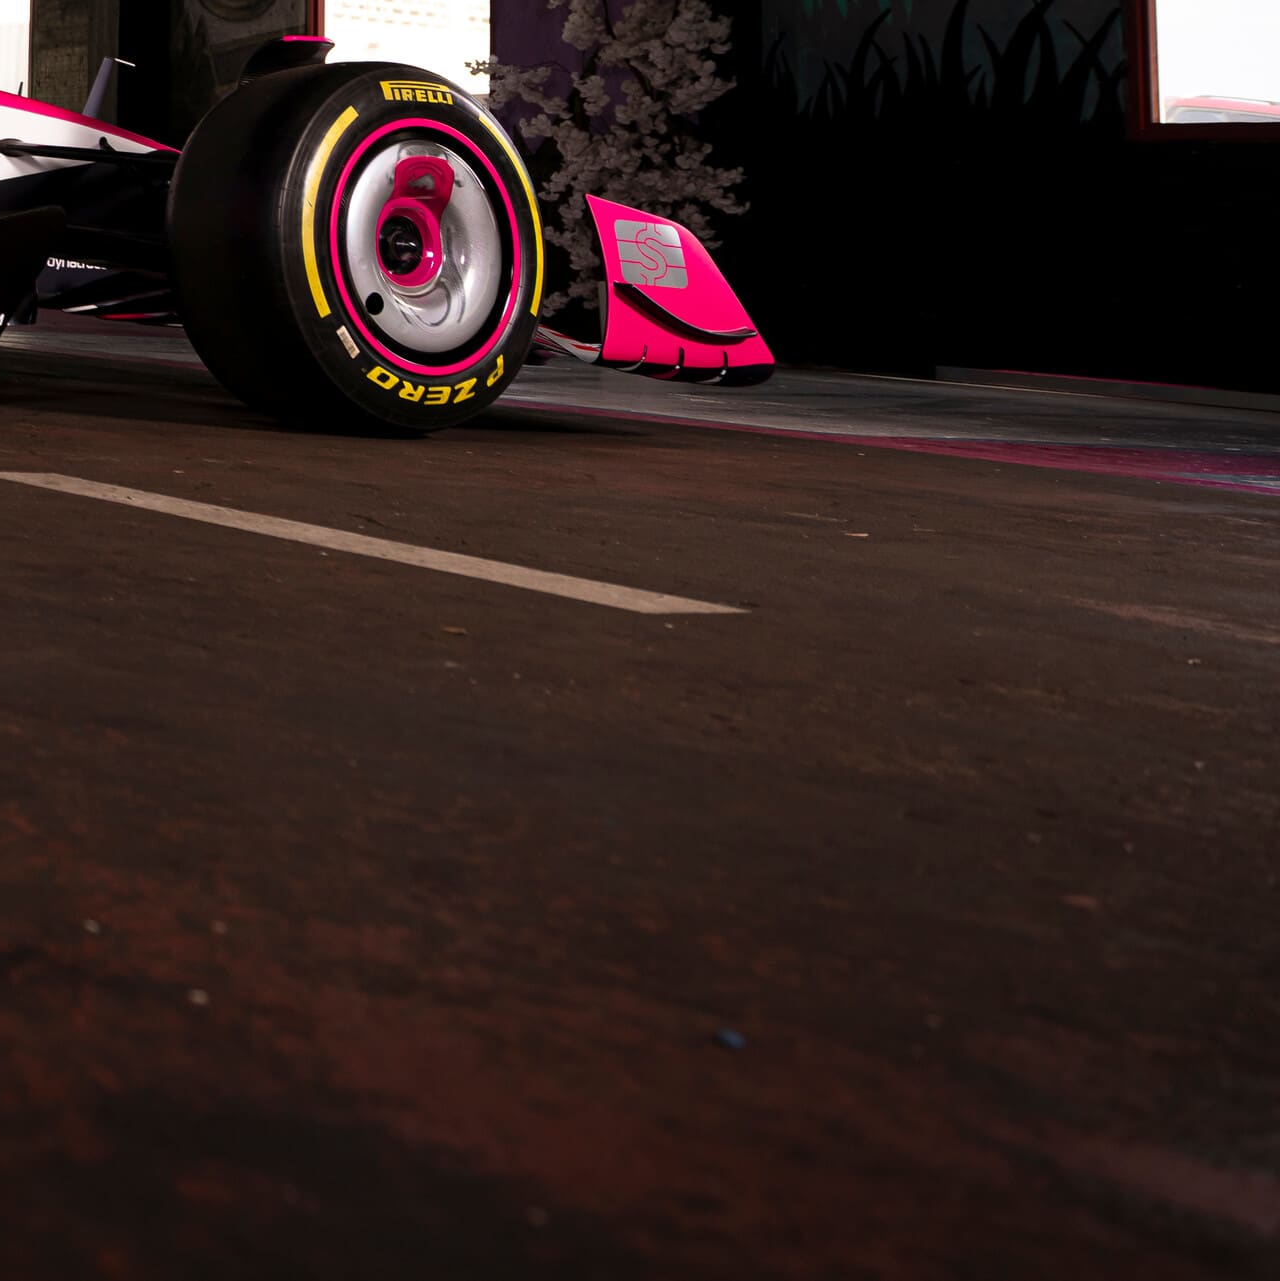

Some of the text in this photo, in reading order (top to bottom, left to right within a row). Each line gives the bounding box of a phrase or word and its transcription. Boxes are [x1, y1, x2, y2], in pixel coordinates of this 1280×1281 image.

[379, 79, 454, 105] PIRELLI
[366, 354, 504, 406] P ZERO
